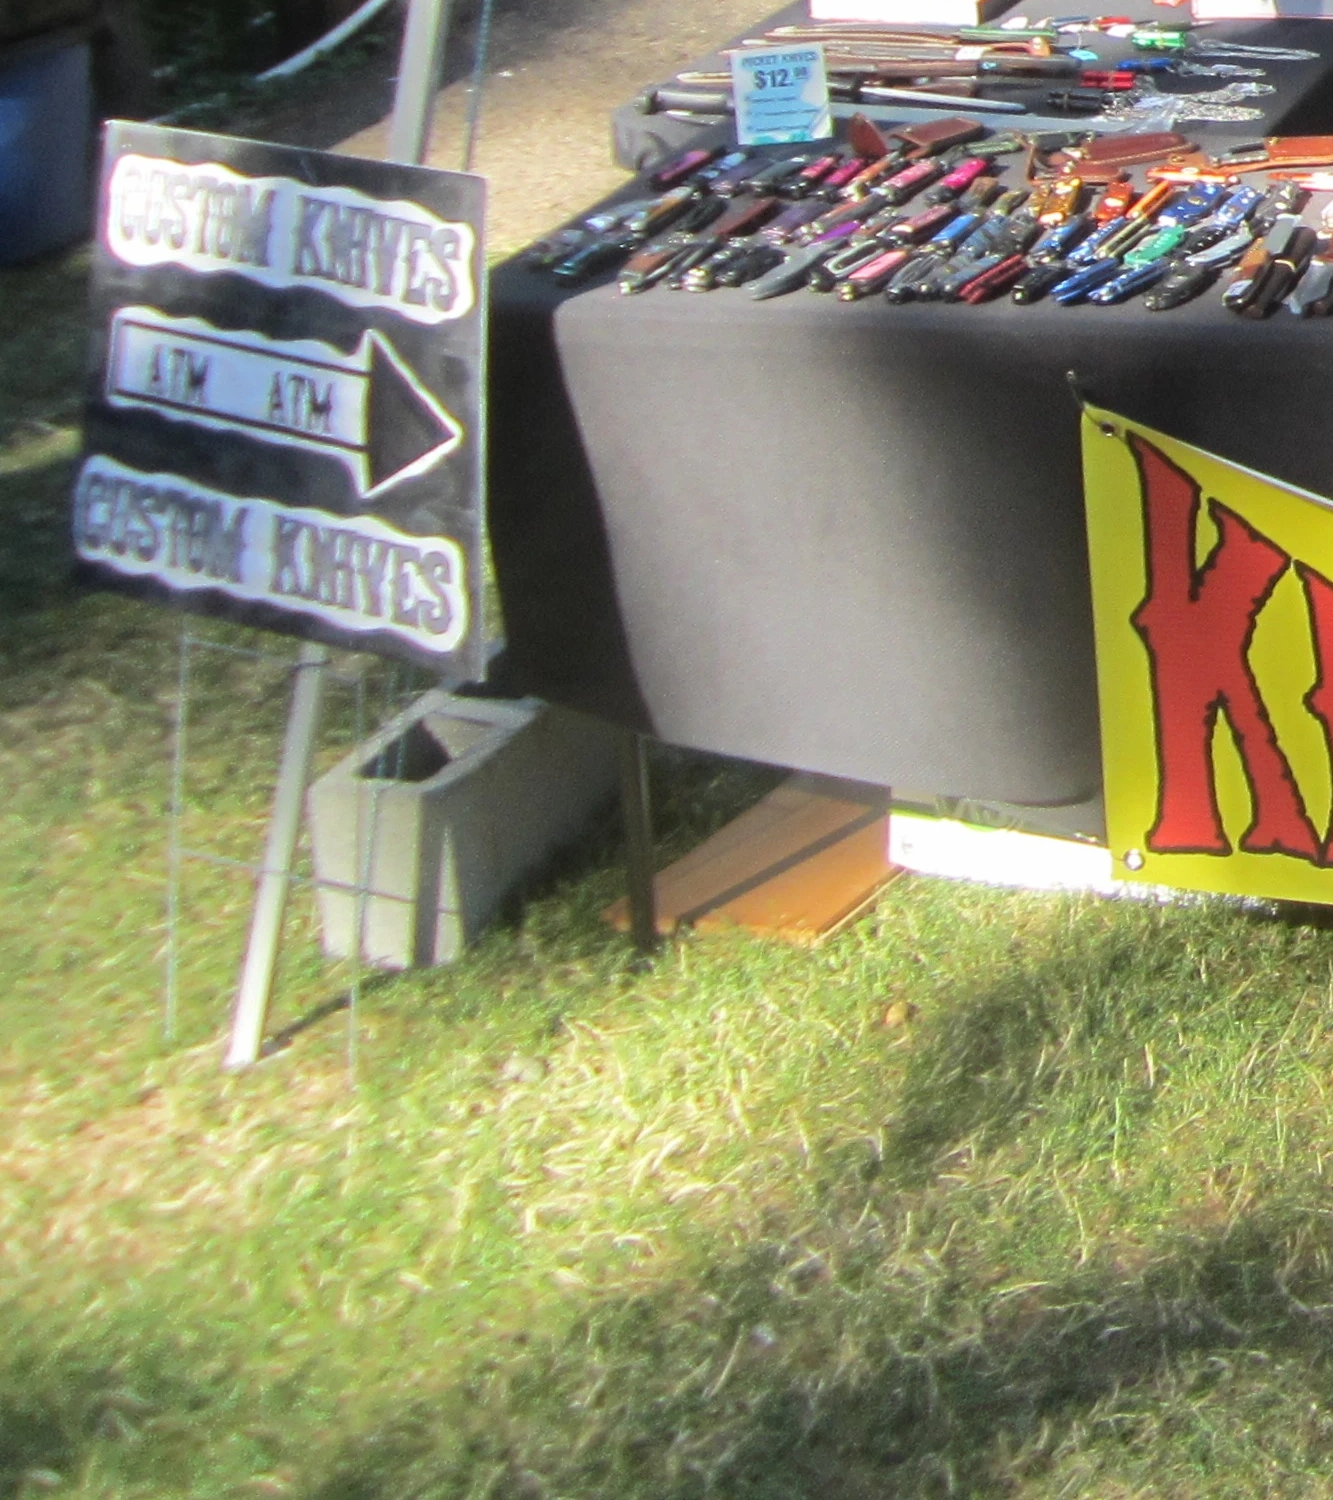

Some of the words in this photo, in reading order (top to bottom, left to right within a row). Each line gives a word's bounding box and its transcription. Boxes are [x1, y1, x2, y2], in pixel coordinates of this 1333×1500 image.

[118, 166, 274, 269] CUSTOM
[293, 193, 458, 313] KNIVES
[147, 344, 211, 404] ATM
[268, 371, 334, 434] ATM
[82, 471, 247, 584] CUSTOM
[271, 513, 452, 636] KNIVES
